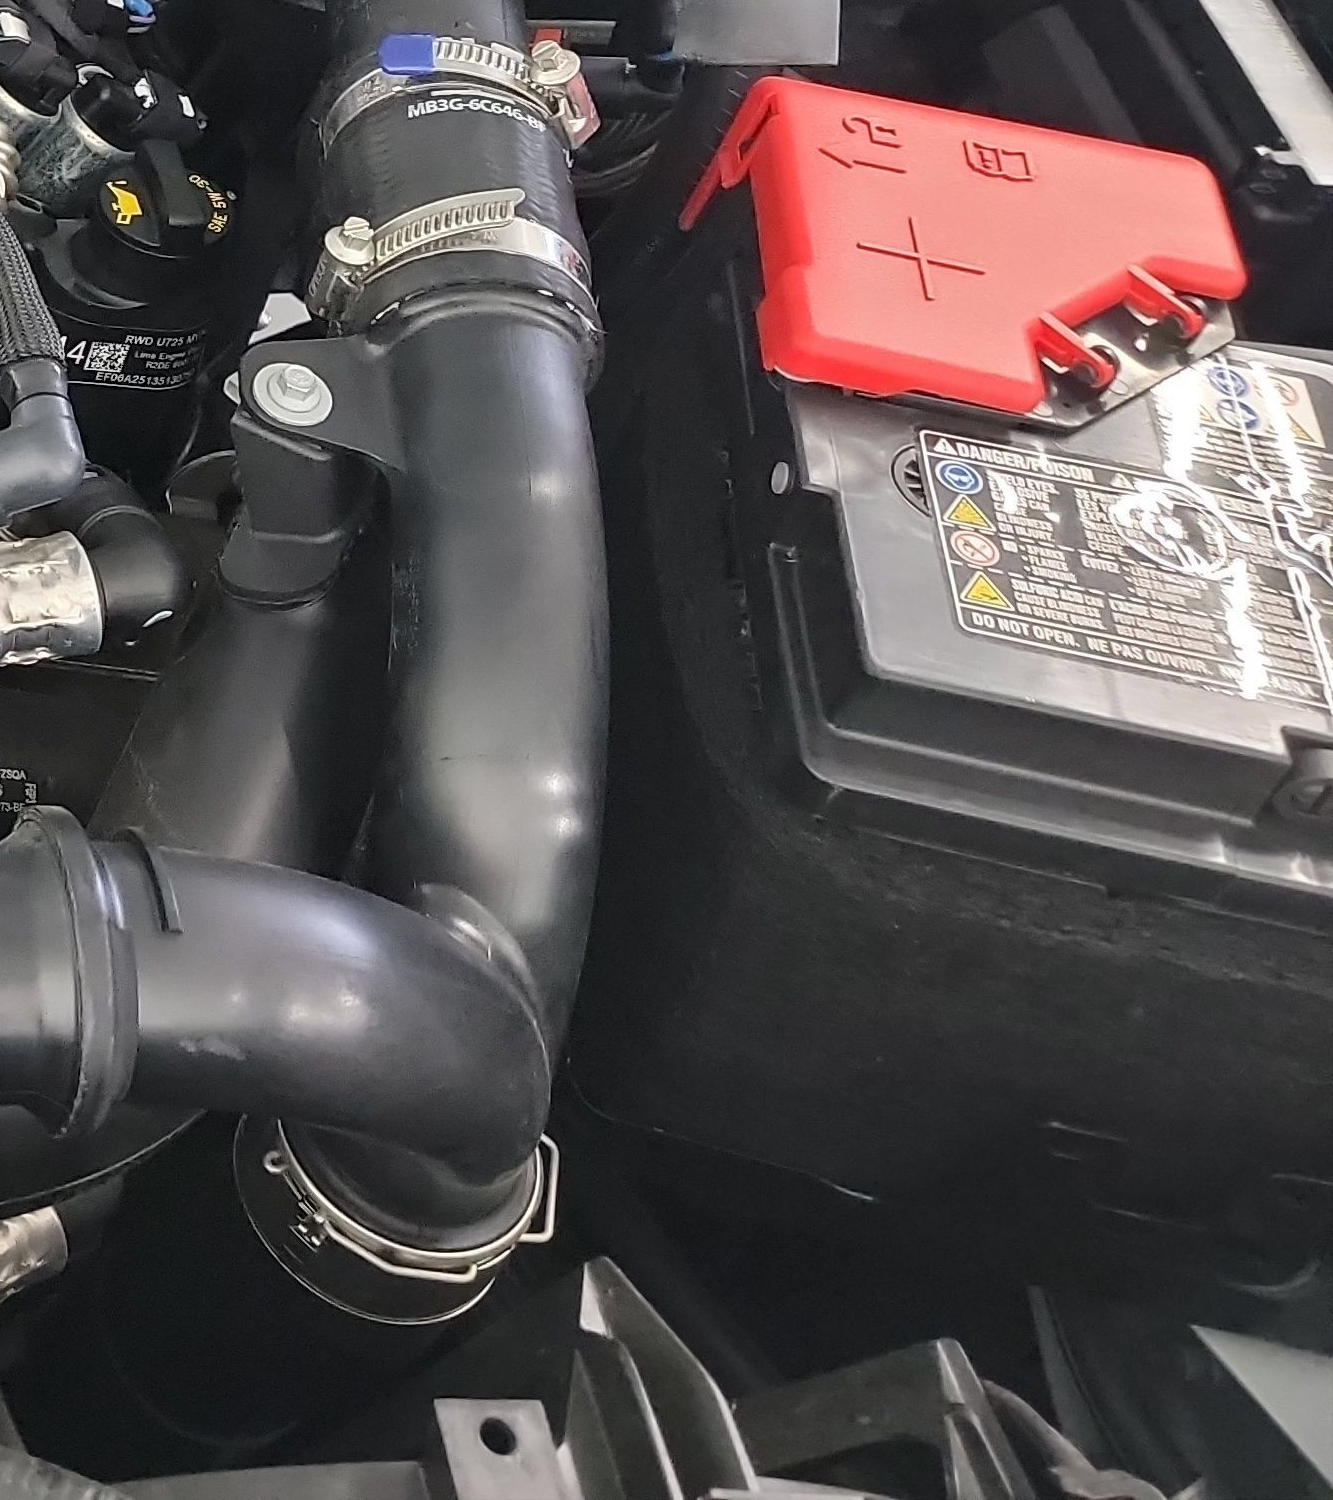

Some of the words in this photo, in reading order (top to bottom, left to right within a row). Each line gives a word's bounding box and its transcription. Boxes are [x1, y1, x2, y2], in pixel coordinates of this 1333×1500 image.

[188, 174, 227, 209] 5W-30
[208, 211, 228, 233] SAE
[125, 335, 153, 345] RWD
[157, 336, 184, 347] U725
[955, 442, 1094, 482] DANGER/POISON
[970, 611, 996, 629] DO
[996, 617, 1031, 636] NOT
[1031, 624, 1081, 647] OPEN.
[1086, 636, 1110, 653] NE
[1110, 641, 1144, 661] PAS
[1144, 648, 1214, 676] OUVRIR.
